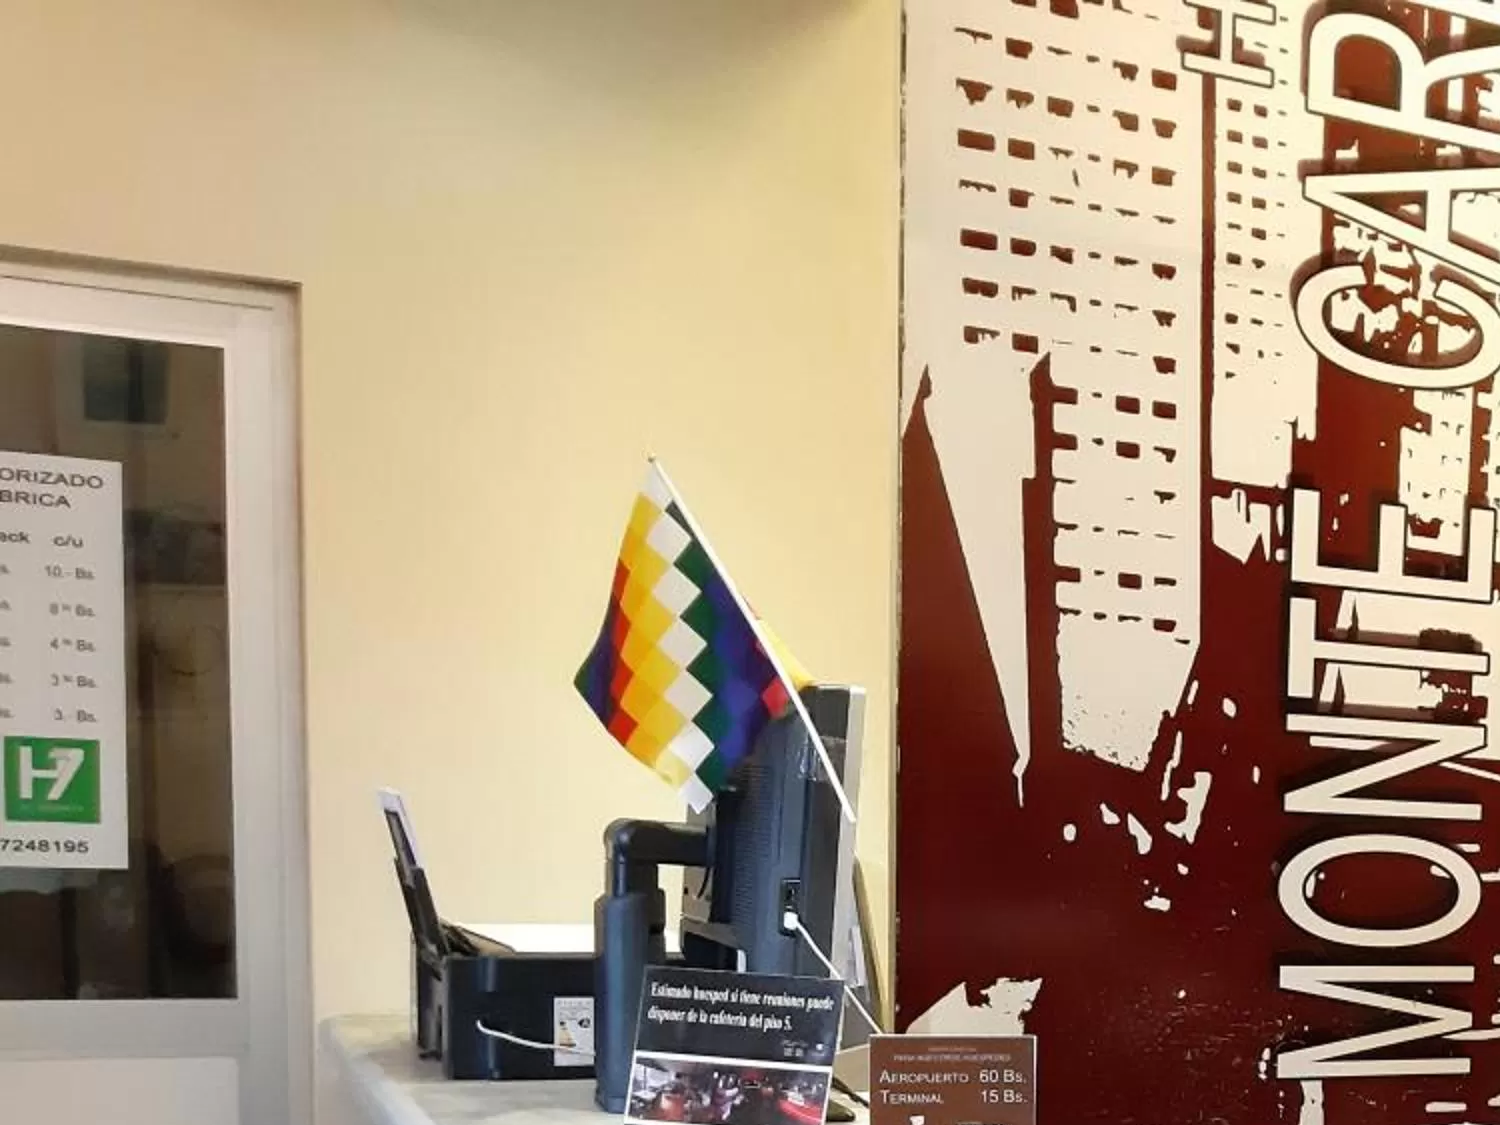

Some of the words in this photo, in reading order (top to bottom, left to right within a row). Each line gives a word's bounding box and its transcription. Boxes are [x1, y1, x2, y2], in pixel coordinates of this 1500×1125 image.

[1276, 488, 1498, 1081] MONTE
[879, 1069, 969, 1084] AEROPUERTO
[979, 1069, 999, 1083] 60
[879, 1089, 944, 1104] TERMINAL
[981, 1089, 999, 1103] 15
